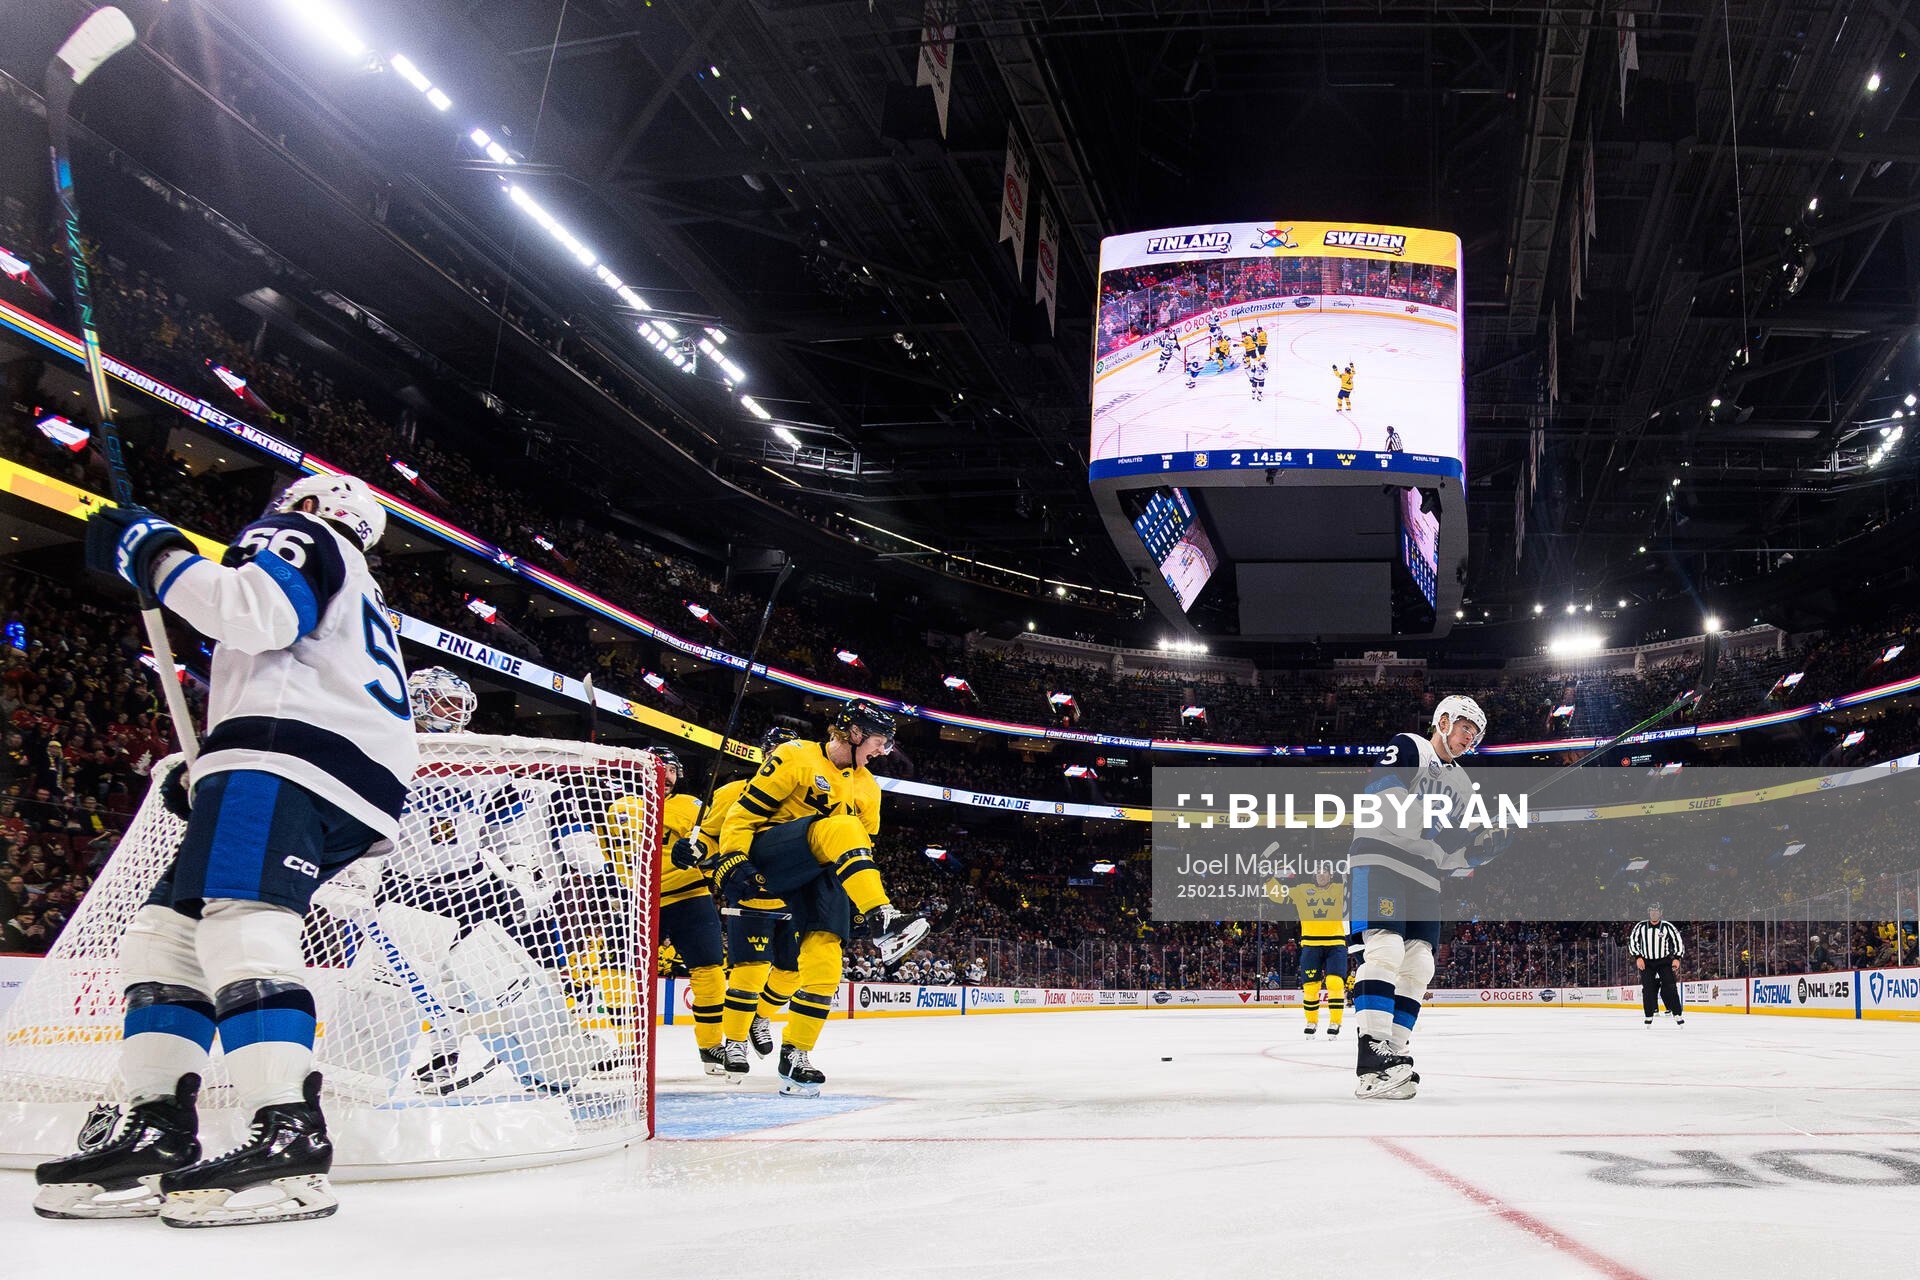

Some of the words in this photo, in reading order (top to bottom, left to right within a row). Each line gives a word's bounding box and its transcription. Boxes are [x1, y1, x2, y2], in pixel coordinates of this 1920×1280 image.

[1148, 232, 1231, 252] FINLAND
[1324, 230, 1406, 250] SWEDEN
[1231, 301, 1286, 317] ticketmaster
[1194, 309, 1228, 328] ROGRS
[101, 354, 200, 417] ONFRONTATION
[201, 405, 227, 427] DES
[242, 429, 301, 464] NATIONS
[1231, 453, 1241, 465] 2
[1253, 452, 1292, 462] 14:54
[1306, 452, 1313, 464] 1
[356, 520, 372, 540] 56
[239, 527, 314, 569] 56
[437, 630, 522, 676] FINLANDE
[654, 628, 706, 655] CONFRONTATION
[707, 650, 722, 660] DES
[731, 657, 766, 674] NATONS
[1046, 730, 1097, 742] CONFRONTATION
[1120, 738, 1150, 747] NATIONS
[1665, 728, 1695, 738] NATIONS
[971, 794, 1030, 811] FINLANDE
[1493, 991, 1533, 1001] ROGERS
[1753, 980, 1792, 1004] FASTENAL
[1808, 983, 1828, 998] NHL
[1835, 981, 1849, 998] 25
[1888, 978, 1920, 999] FAND
[872, 992, 893, 1004] NHL
[899, 992, 911, 1004] 25
[917, 987, 957, 1008] FASTENAL
[981, 992, 1005, 1003] FANDUEL
[1044, 990, 1067, 1005] TYLENOL
